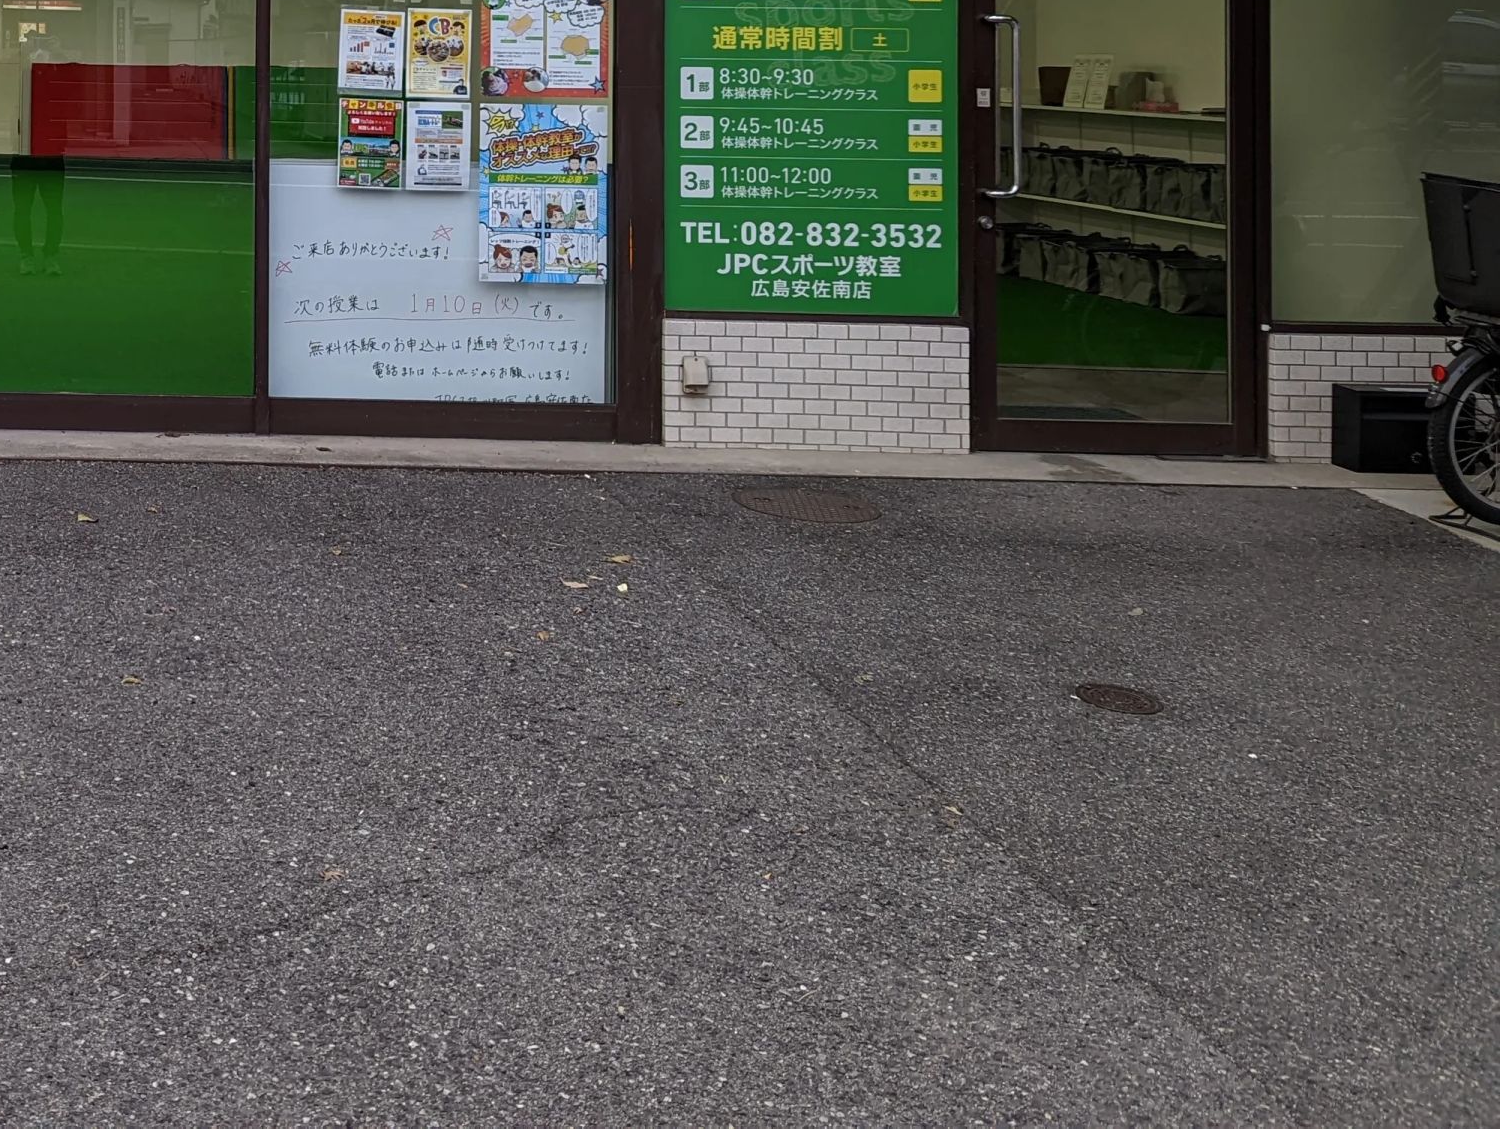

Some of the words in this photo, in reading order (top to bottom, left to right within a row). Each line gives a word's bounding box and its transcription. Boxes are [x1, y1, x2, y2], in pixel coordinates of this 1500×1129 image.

[712, 26, 843, 51] 通常時間割
[872, 33, 888, 47] 土
[721, 87, 878, 101] 体操体幹トレーニングクラス
[721, 136, 878, 150] 体操体幹トレーニングクラス
[721, 186, 878, 199] 体操体幹トレーニングクラス
[716, 253, 902, 277] JPCスポーツ教室
[751, 279, 872, 299] 広島安佐南店
